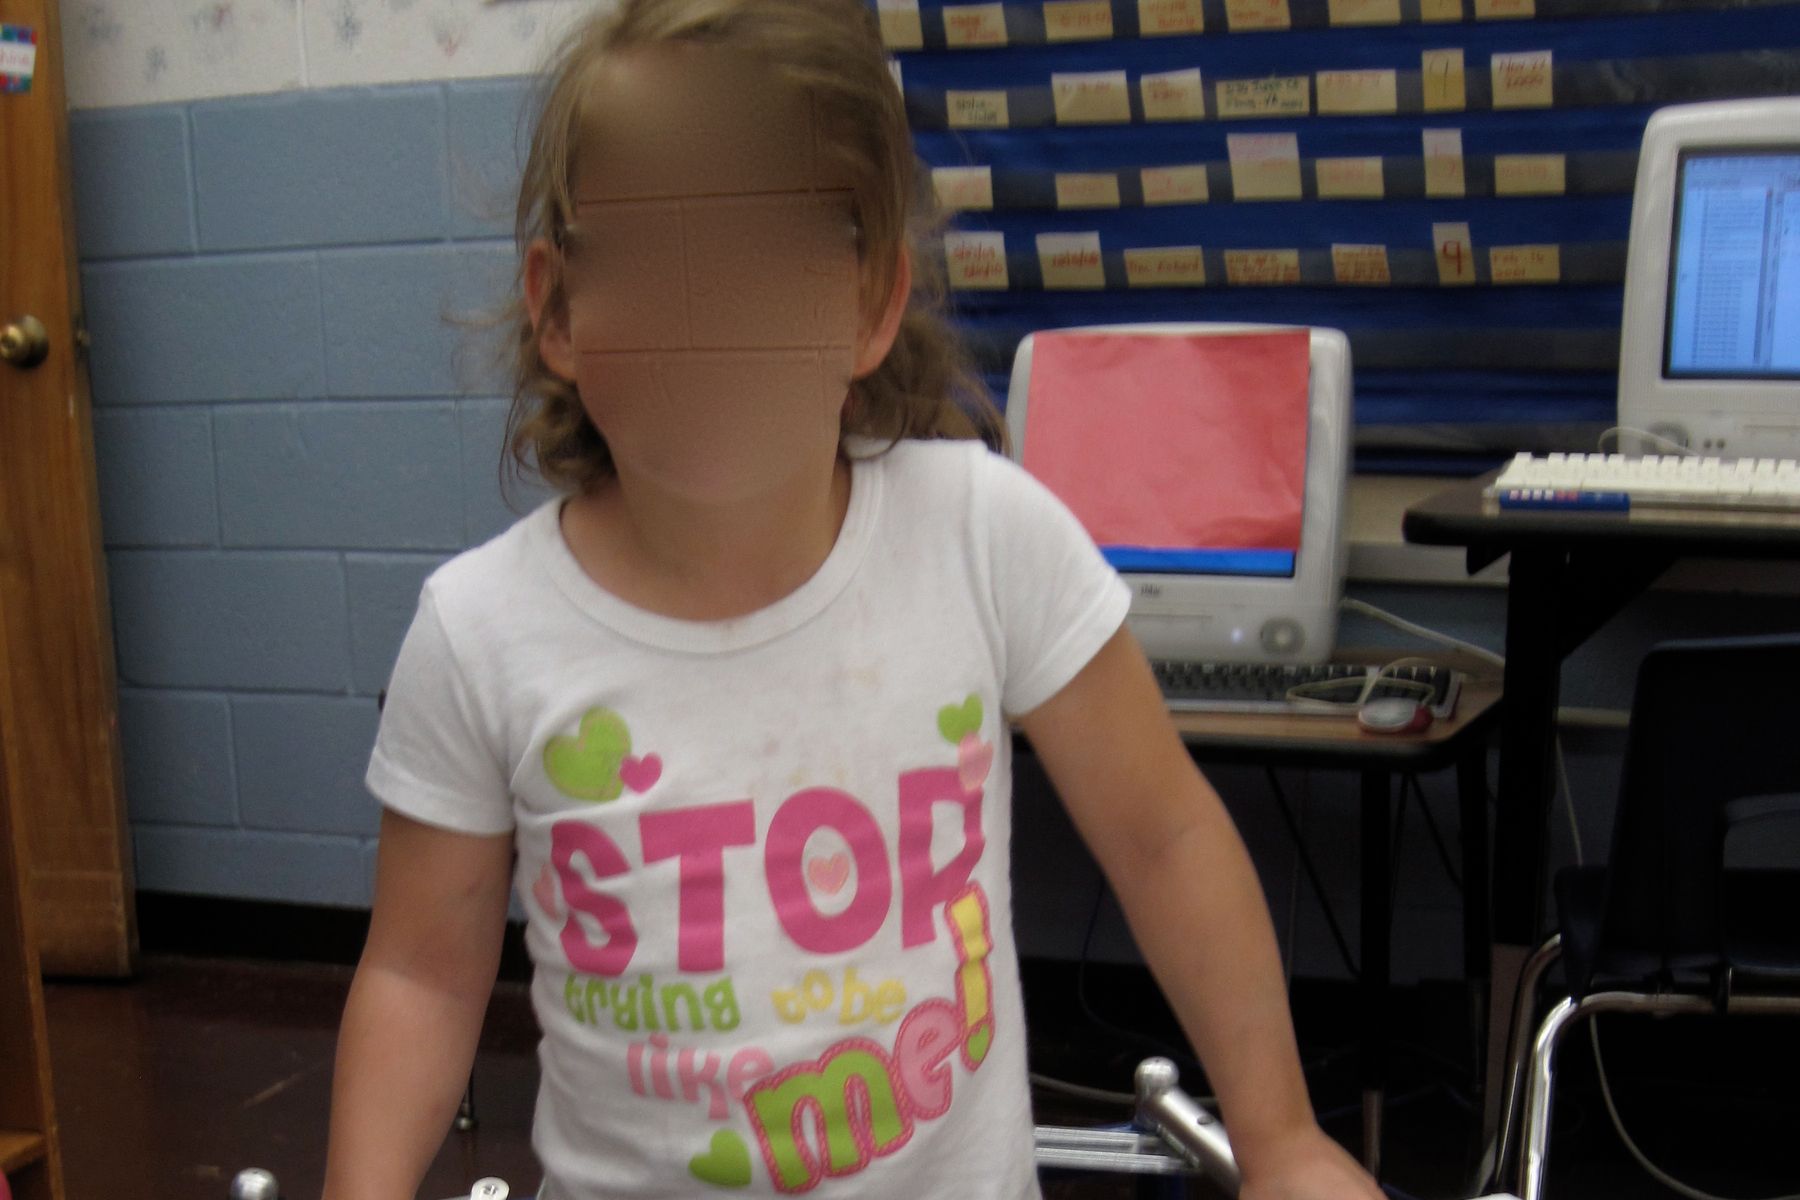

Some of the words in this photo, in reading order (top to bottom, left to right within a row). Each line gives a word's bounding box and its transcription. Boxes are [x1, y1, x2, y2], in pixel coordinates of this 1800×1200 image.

[551, 765, 986, 977] STOP
[564, 972, 741, 1032] trying
[772, 969, 834, 1026] to
[838, 966, 906, 1026] be
[627, 1033, 775, 1121] like
